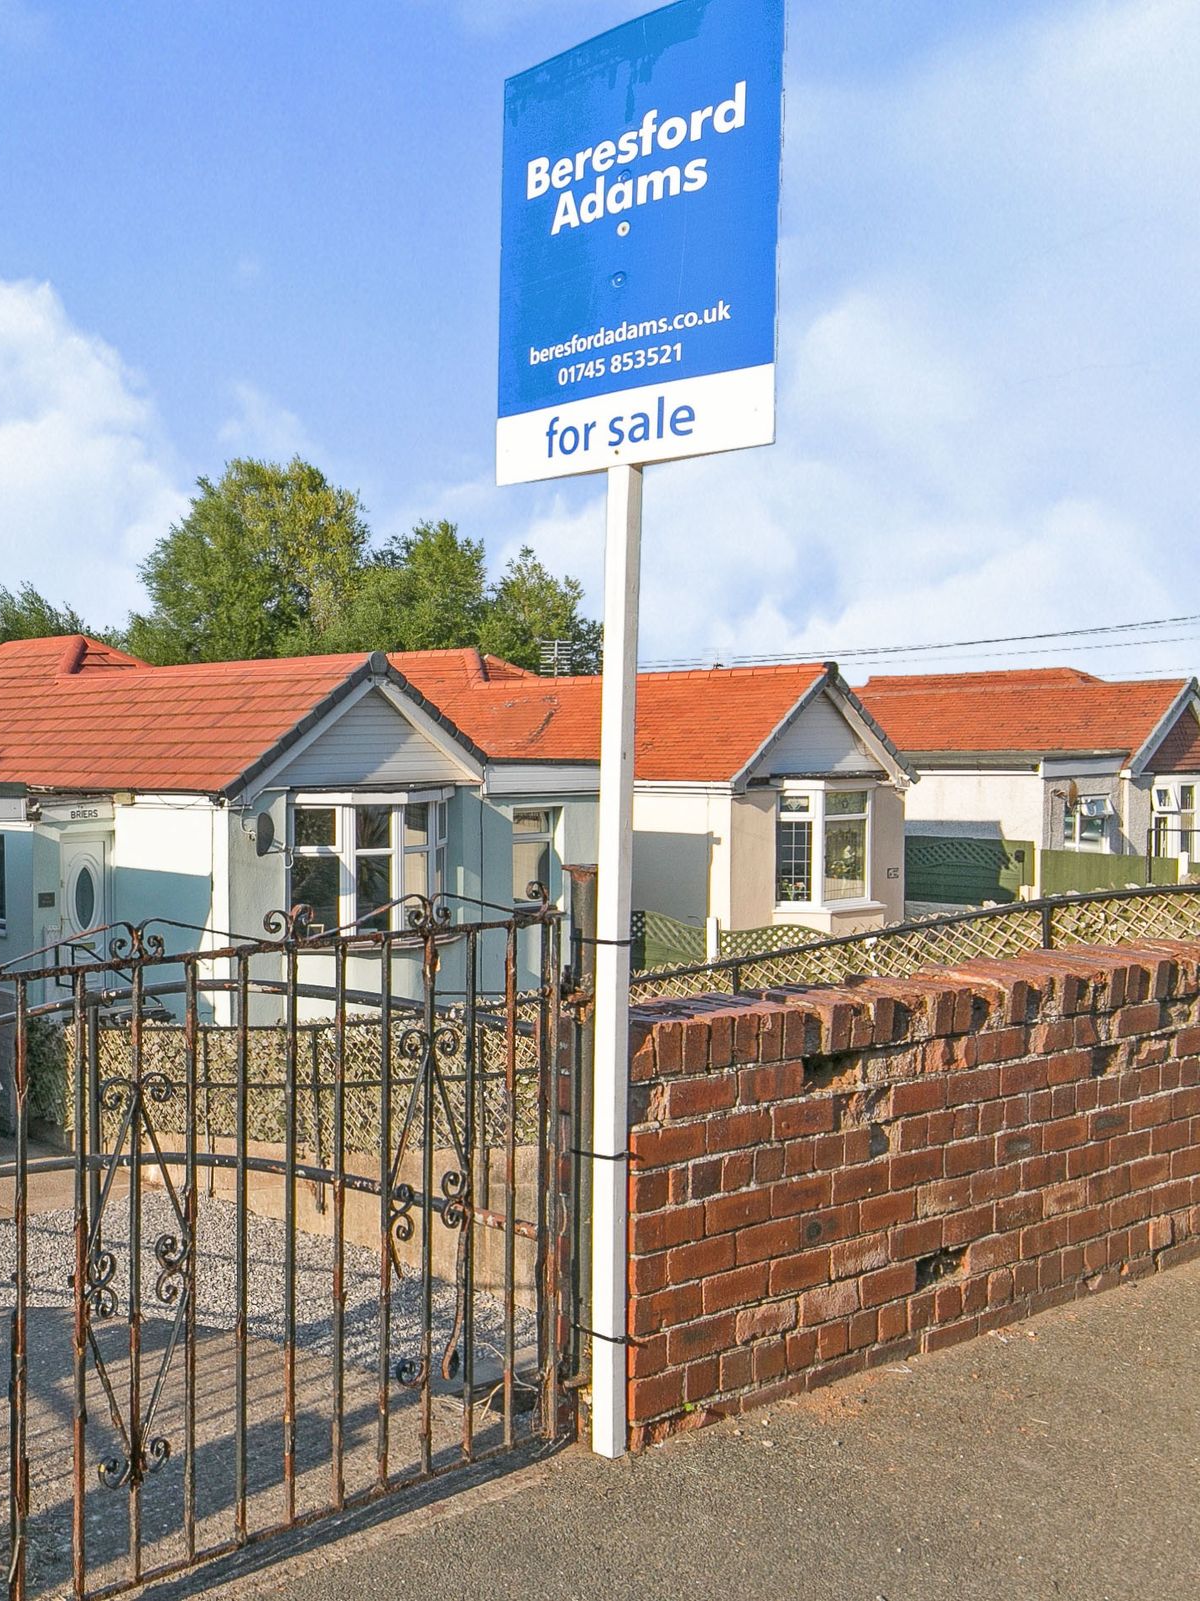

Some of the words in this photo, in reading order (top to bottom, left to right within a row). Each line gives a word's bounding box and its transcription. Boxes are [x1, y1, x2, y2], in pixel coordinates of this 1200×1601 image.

[526, 80, 747, 200] Beresford
[551, 158, 708, 236] Adams
[529, 300, 731, 366] beresfordadams.co.uk
[558, 358, 605, 386] 01745
[610, 342, 682, 374] 853521
[546, 416, 596, 458] for
[608, 396, 696, 447] sale
[70, 809, 99, 819] BRIERS
